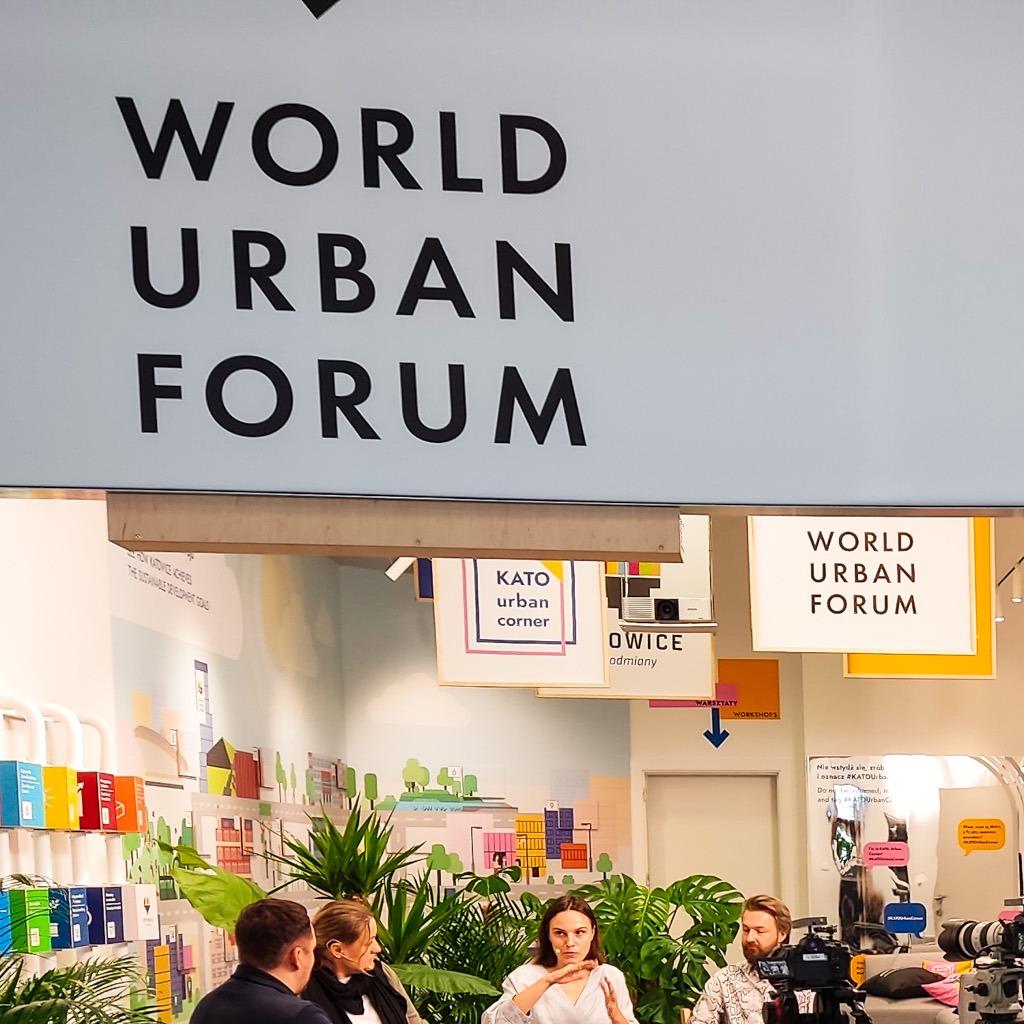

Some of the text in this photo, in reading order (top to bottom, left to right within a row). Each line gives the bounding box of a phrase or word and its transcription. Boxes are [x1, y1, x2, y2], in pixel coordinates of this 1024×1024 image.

[115, 96, 567, 194] WORLD
[130, 225, 575, 322] URBAN
[137, 353, 587, 447] FORUM
[807, 531, 914, 552] WORLD
[496, 570, 550, 587] KATO
[810, 563, 916, 583] URBAN
[497, 592, 549, 609] urban
[811, 594, 917, 614] FORUM
[497, 615, 550, 628] corner
[609, 655, 657, 669] odmiany
